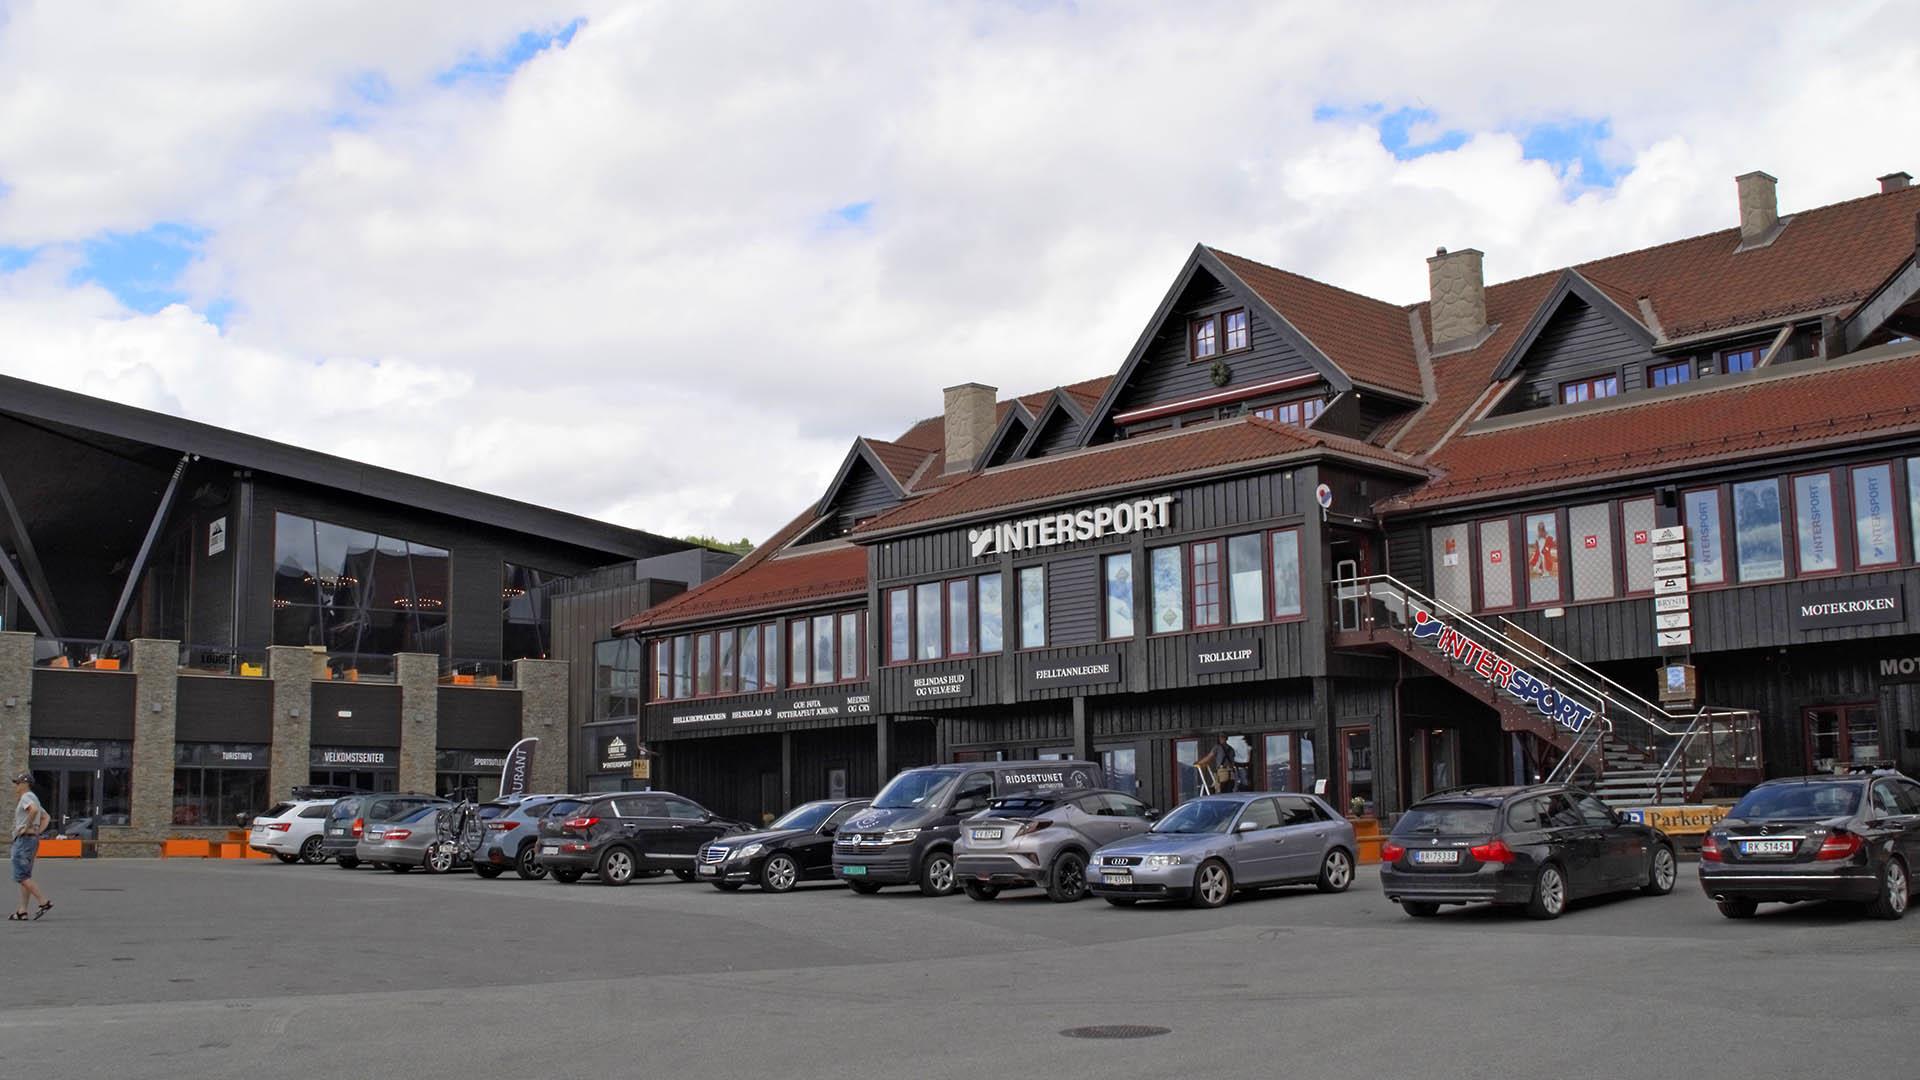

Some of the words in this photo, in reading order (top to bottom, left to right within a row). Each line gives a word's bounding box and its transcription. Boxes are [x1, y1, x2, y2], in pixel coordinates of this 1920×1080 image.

[1868, 476, 1883, 545] INTERSPORT
[994, 496, 1174, 553] INTERSPORT
[1809, 484, 1824, 553] INTERSPORT
[1698, 502, 1712, 565] INTERSPORT
[1801, 598, 1895, 617] MOTEKROKEN
[1198, 650, 1252, 664] TROLLKLIPP
[1035, 664, 1110, 679] FJELLTANNLEGENE
[914, 676, 948, 687] BELINDAS
[948, 674, 965, 684] HUD
[1437, 625, 1597, 732] INTERSPORT
[916, 687, 927, 696] OG
[927, 684, 961, 695] VELVÆRE
[764, 708, 772, 716] AS
[848, 704, 857, 712] OG
[48, 748, 65, 756] AKTIV
[65, 748, 71, 757] &
[71, 748, 99, 757] SKISKOLE
[324, 751, 384, 763] VELKOMSTSENTER
[1005, 773, 1063, 784] RIDDERTUNET
[1747, 841, 1760, 851] RK
[1763, 841, 1791, 851] 51454
